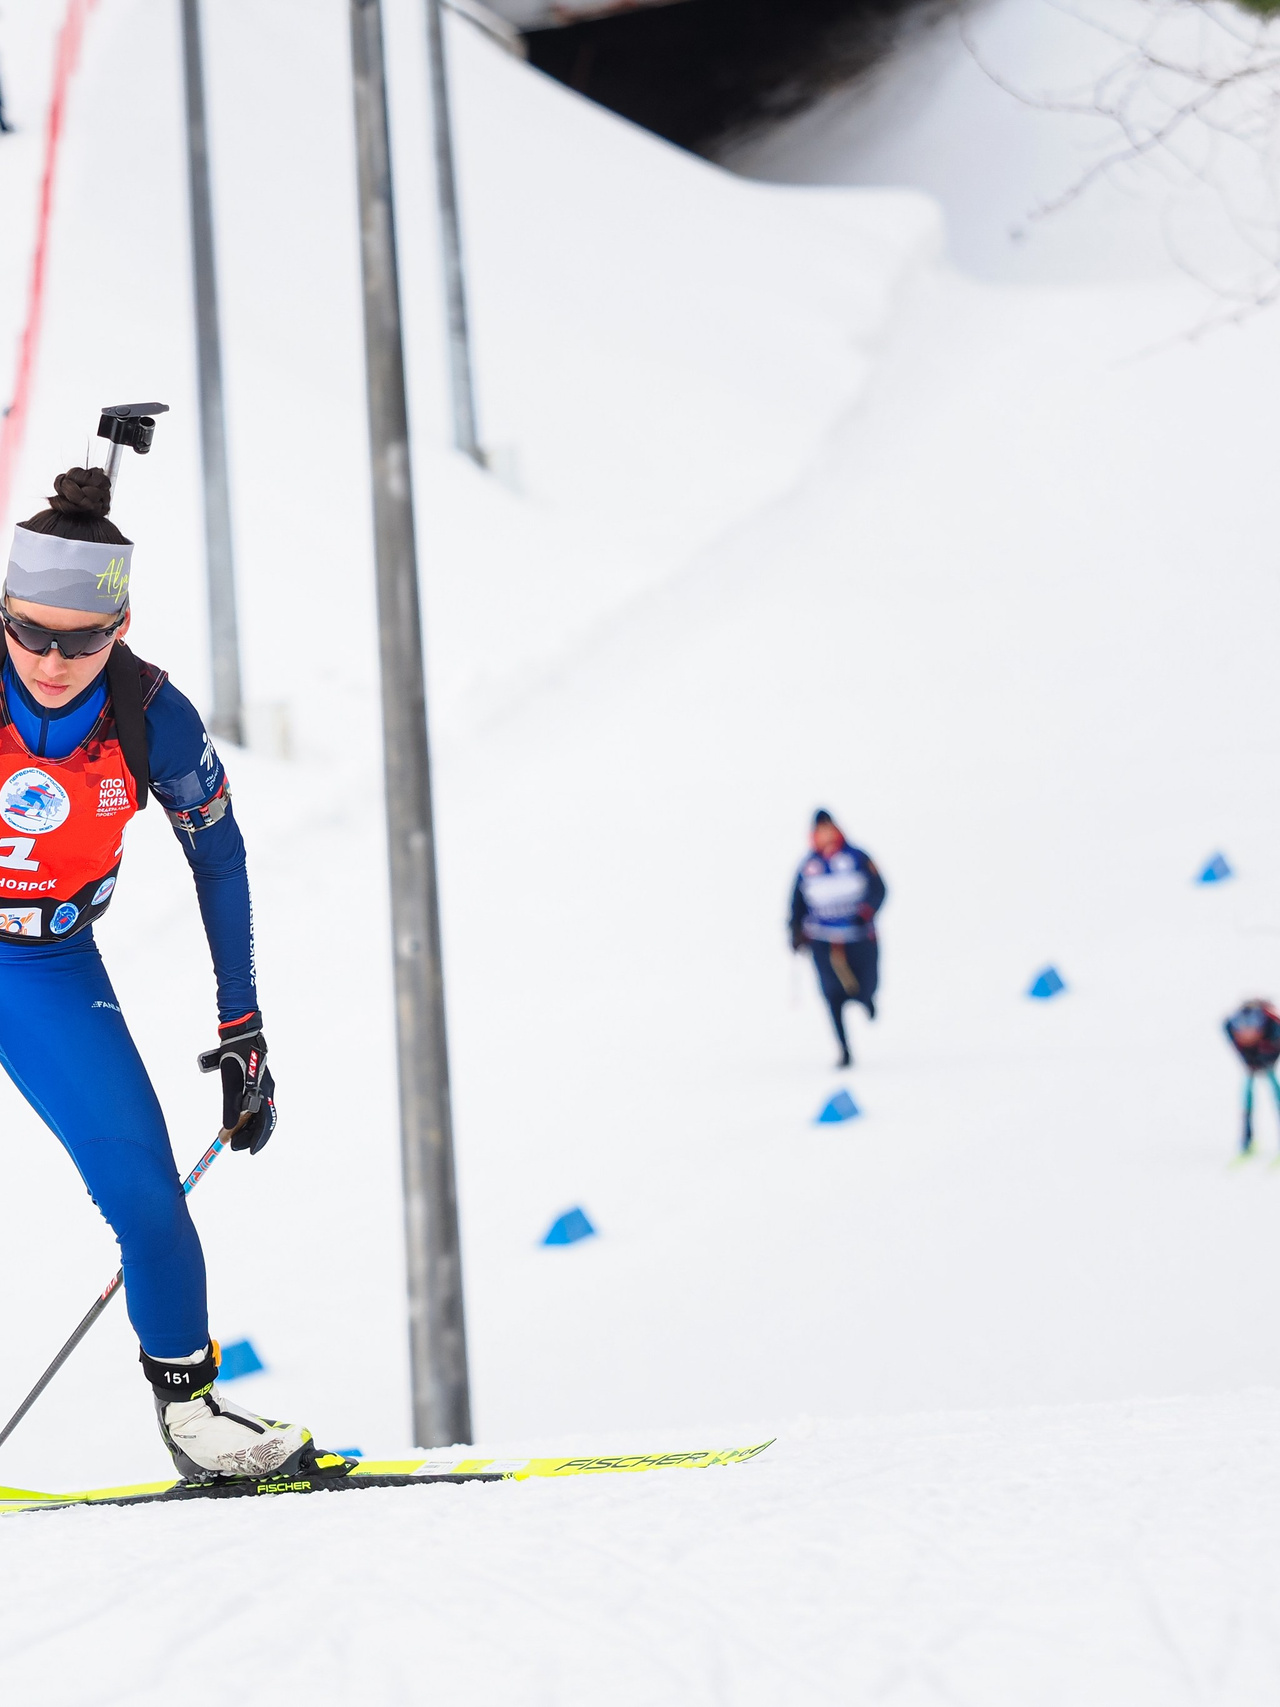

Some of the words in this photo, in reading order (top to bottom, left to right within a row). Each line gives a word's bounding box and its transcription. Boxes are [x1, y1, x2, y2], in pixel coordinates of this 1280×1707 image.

[9, 769, 47, 784] ПЕРВЕНСТВО
[163, 1371, 190, 1385] 151
[554, 1452, 709, 1471] FISCHER
[257, 1481, 311, 1494] FISCHER
